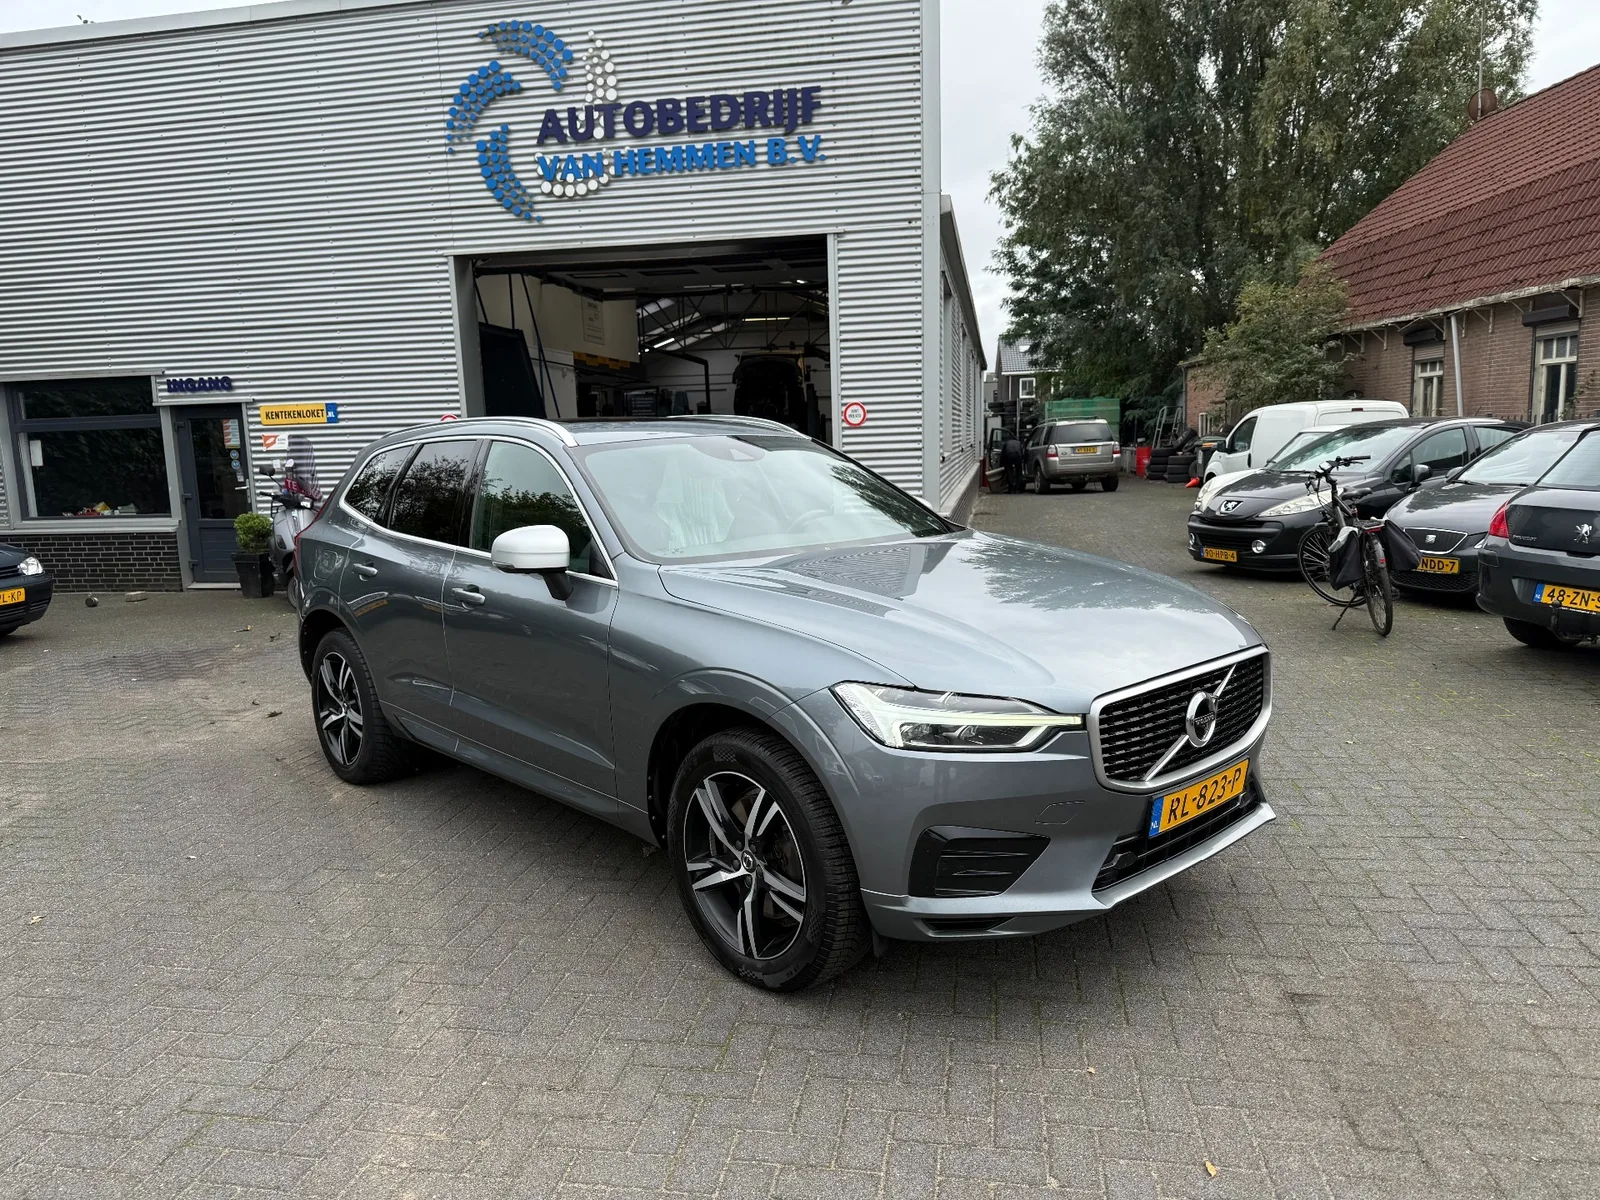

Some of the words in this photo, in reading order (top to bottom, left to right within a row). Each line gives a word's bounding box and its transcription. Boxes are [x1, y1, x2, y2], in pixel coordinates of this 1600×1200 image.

[537, 86, 821, 145] AUTOBEDRIJF
[537, 152, 604, 181] VAN
[614, 140, 756, 176] HEMMEN
[767, 135, 827, 165] B.V.
[166, 376, 232, 393] INGANG
[265, 408, 324, 420] KENTEKENLOKET
[0, 590, 22, 602] L-KP
[1168, 767, 1242, 824] RL-823-P
